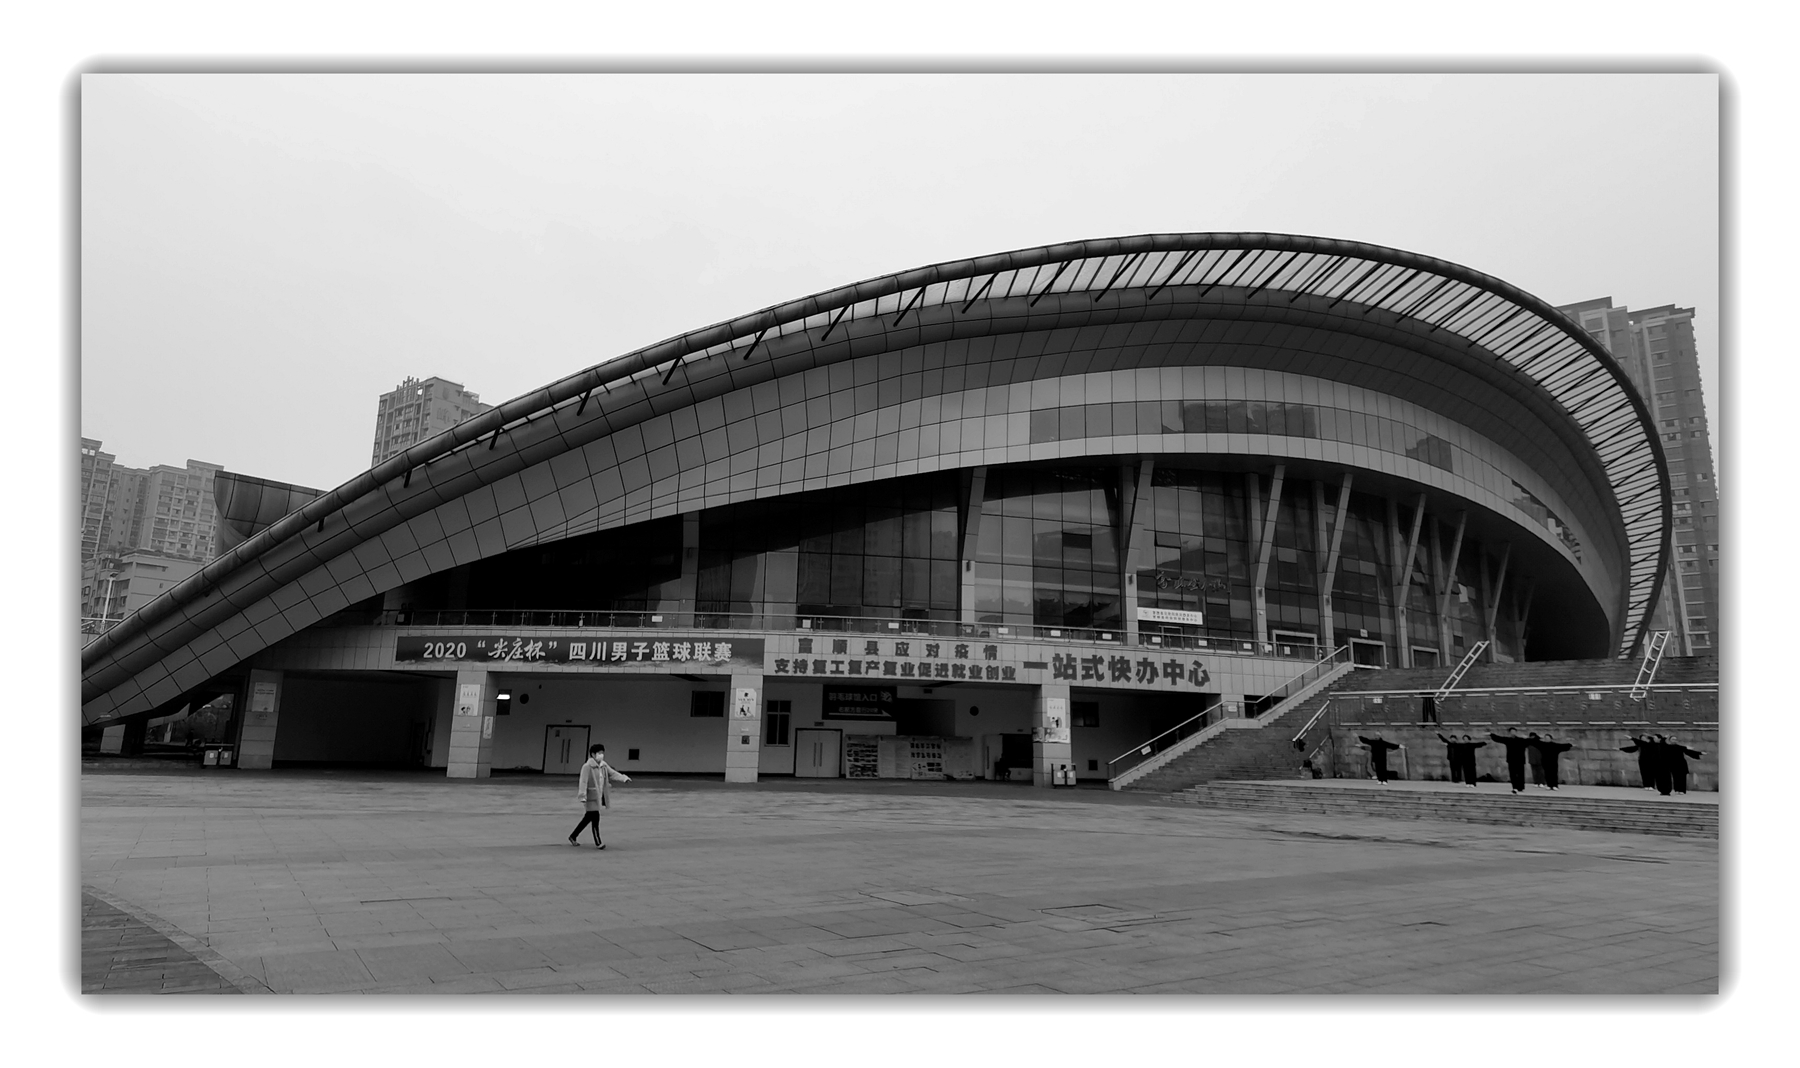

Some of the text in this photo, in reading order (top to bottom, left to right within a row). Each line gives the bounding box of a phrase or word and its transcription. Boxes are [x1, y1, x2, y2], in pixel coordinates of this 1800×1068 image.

[423, 642, 467, 659] 2020
[568, 641, 733, 662] 四川男子篮球联赛
[798, 637, 998, 661] 富顺县应对疫情
[774, 658, 1016, 681] 支持复工复产复业促进就业创业
[1023, 653, 1211, 687] 一站式快办中心
